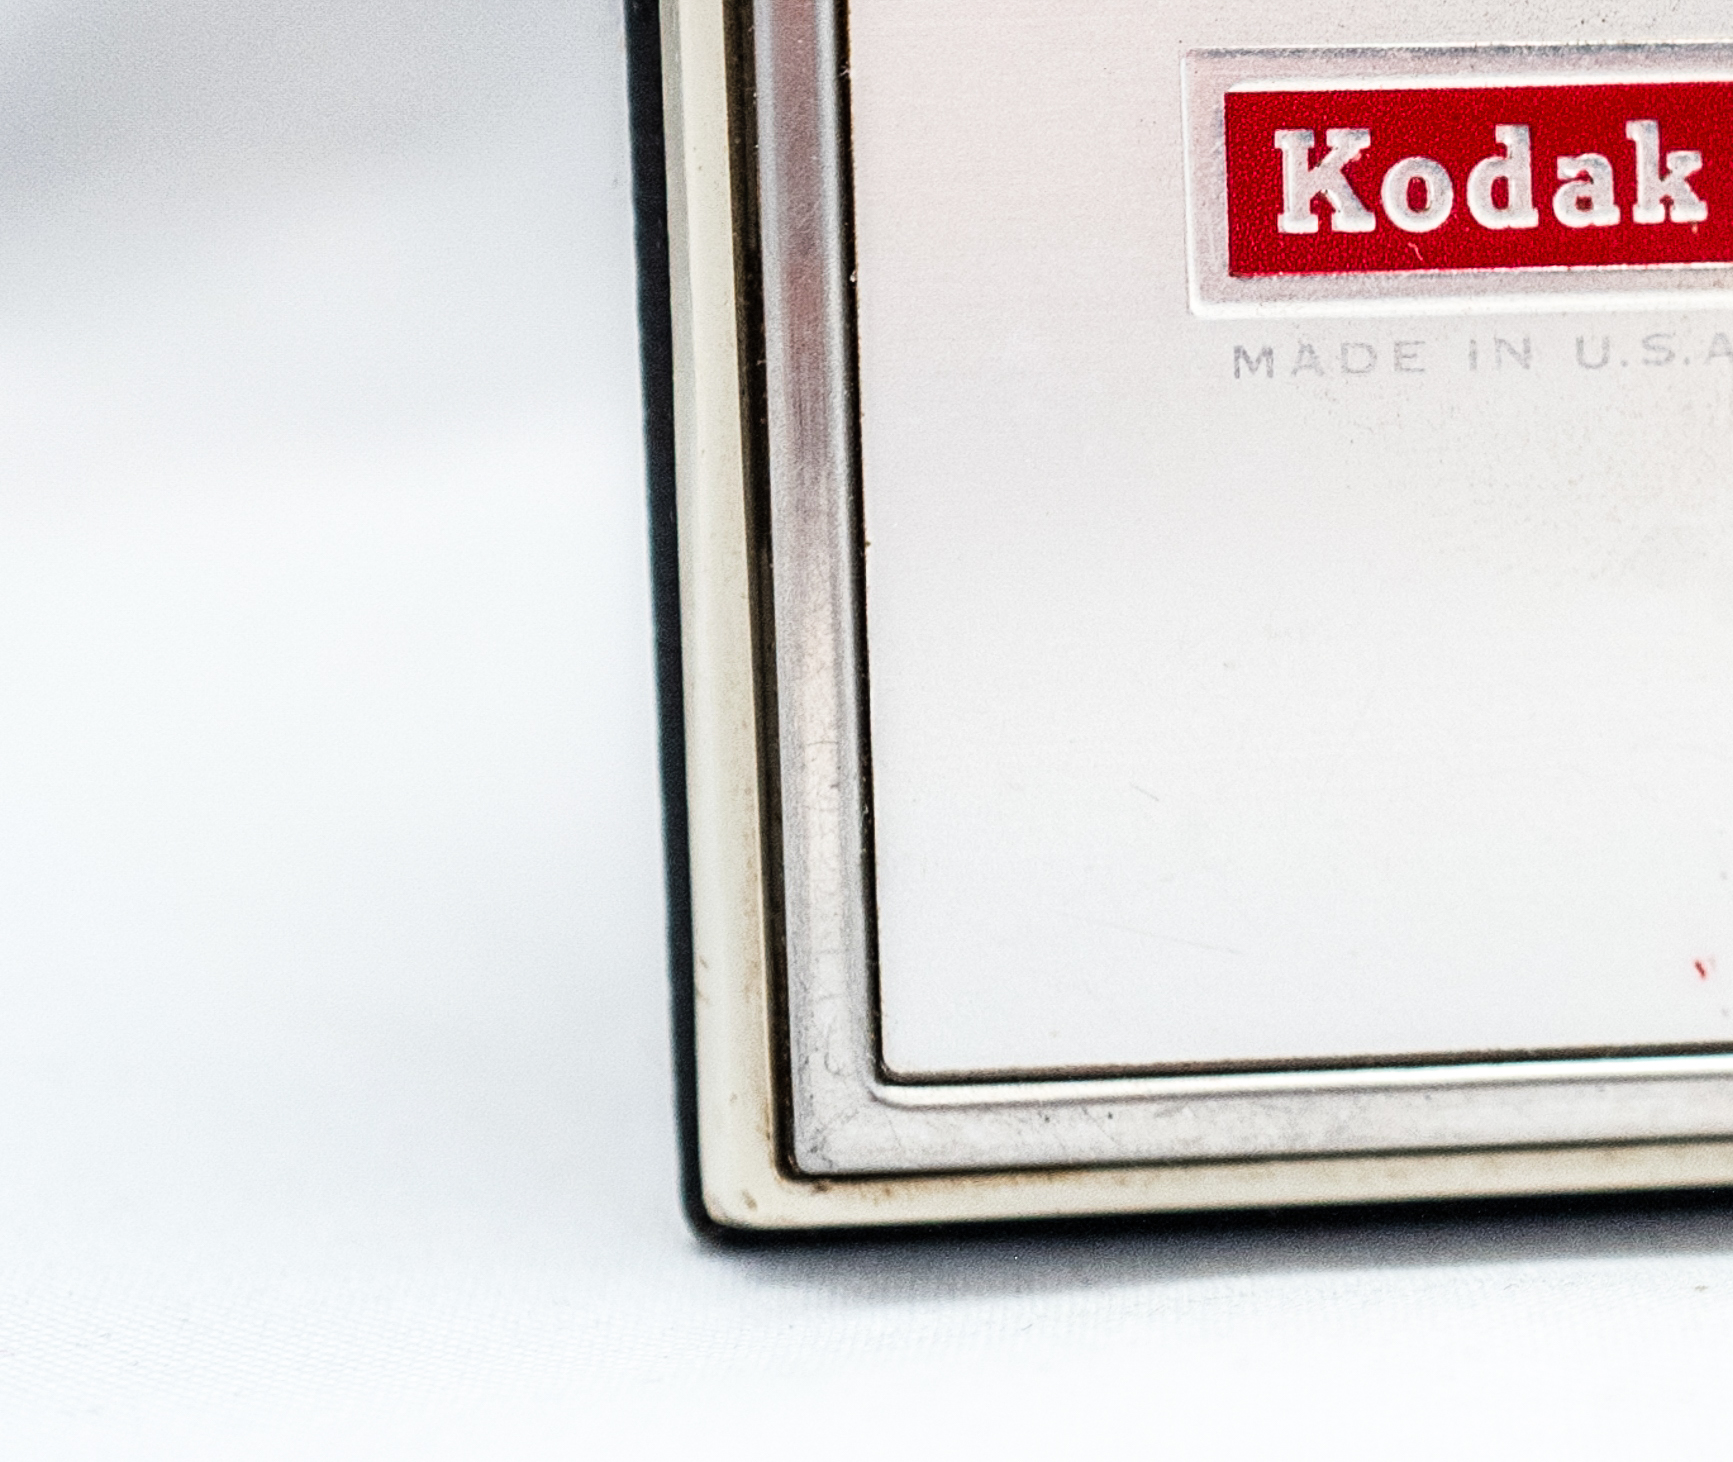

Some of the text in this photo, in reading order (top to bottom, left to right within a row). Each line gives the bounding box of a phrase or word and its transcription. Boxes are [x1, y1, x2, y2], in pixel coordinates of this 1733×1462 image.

[1273, 118, 1709, 235] Kodak
[1231, 338, 1427, 380] MADE
[1467, 335, 1534, 372] IN
